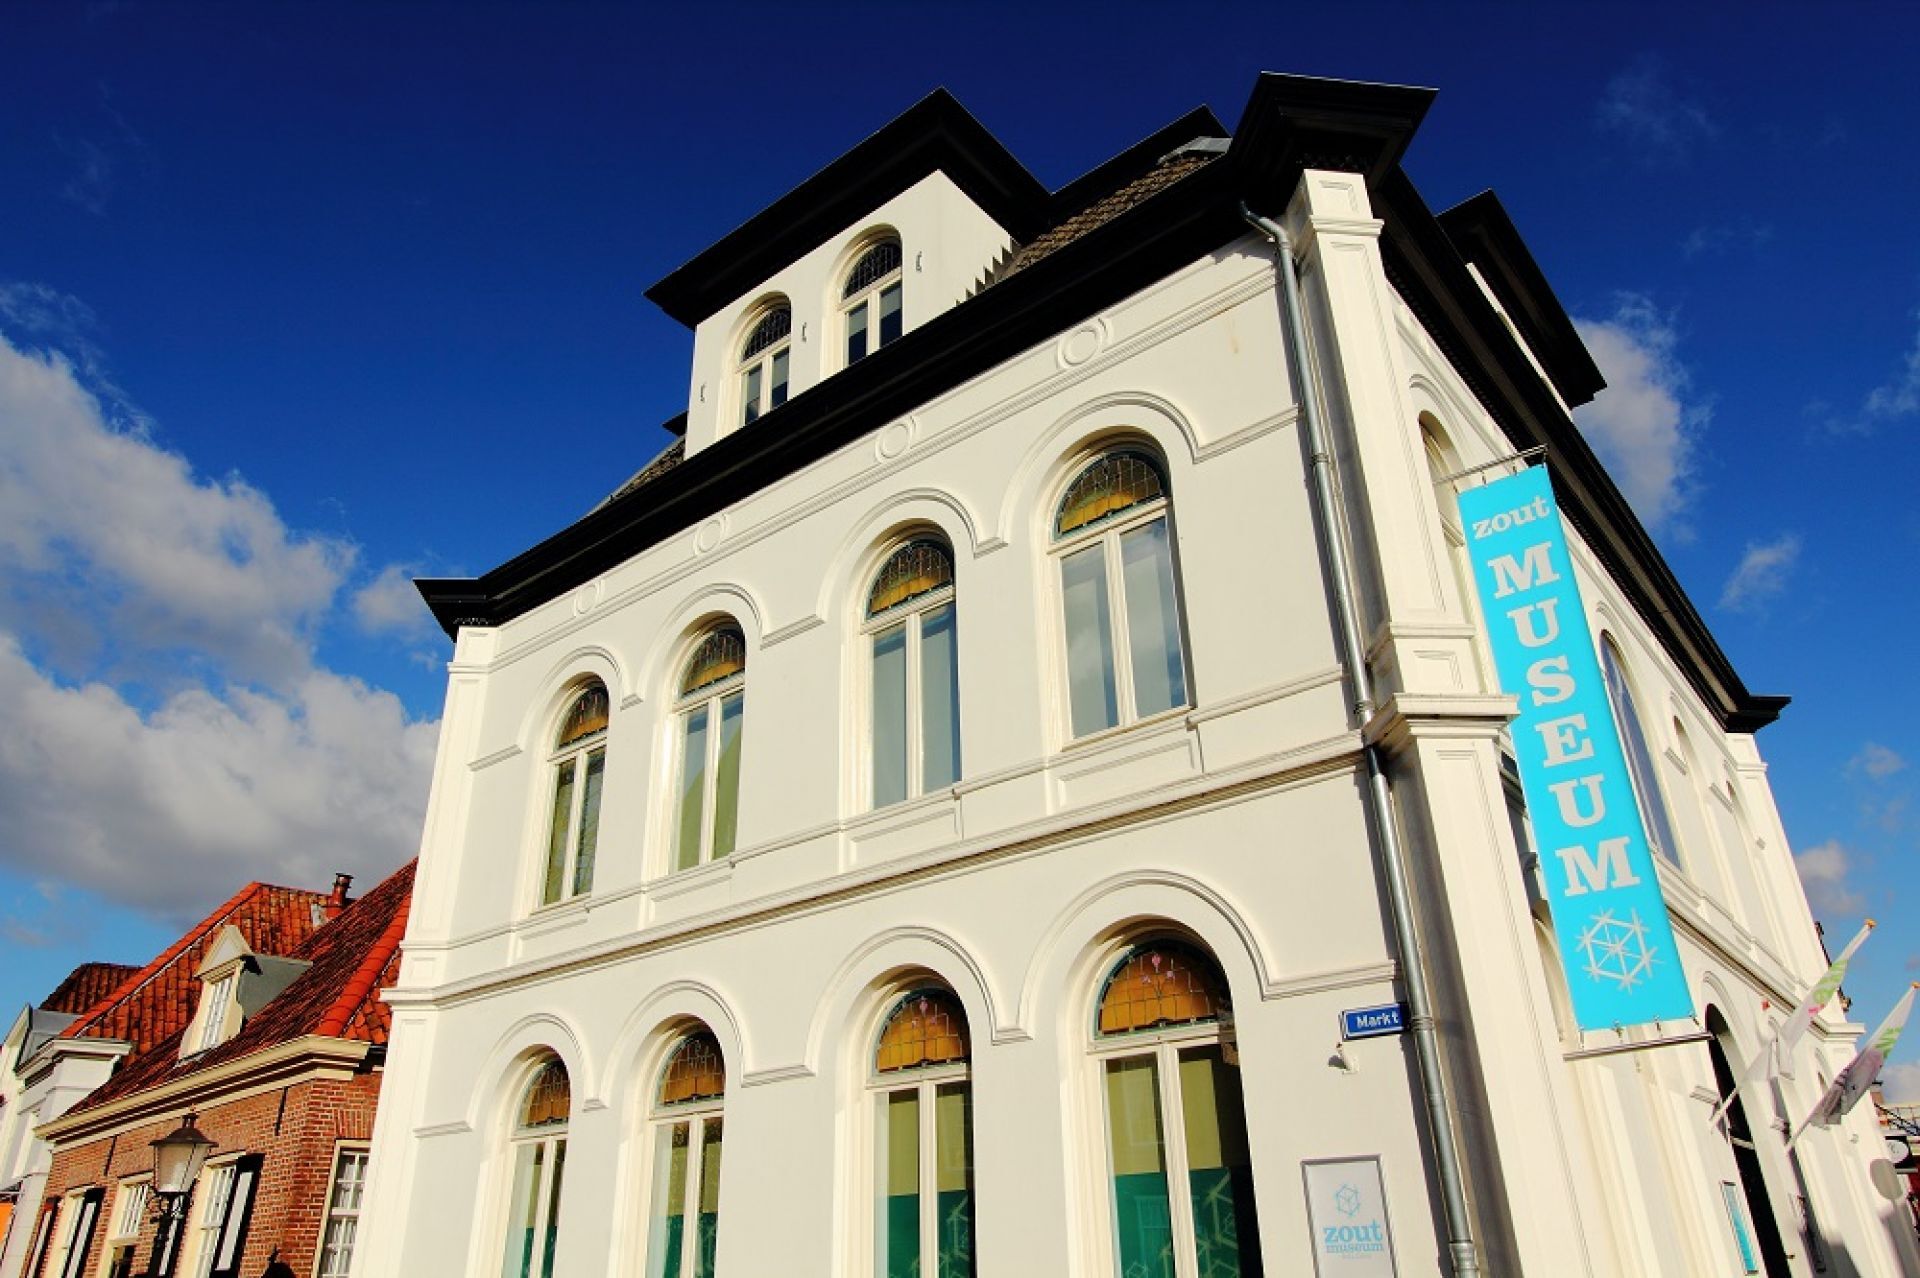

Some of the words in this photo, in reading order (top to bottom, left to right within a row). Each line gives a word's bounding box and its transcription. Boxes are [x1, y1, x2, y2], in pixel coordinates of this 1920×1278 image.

[1472, 495, 1550, 539] zout
[1486, 541, 1641, 897] MUSEUM
[1356, 1011, 1399, 1029] Markt
[1323, 1219, 1383, 1245] zout
